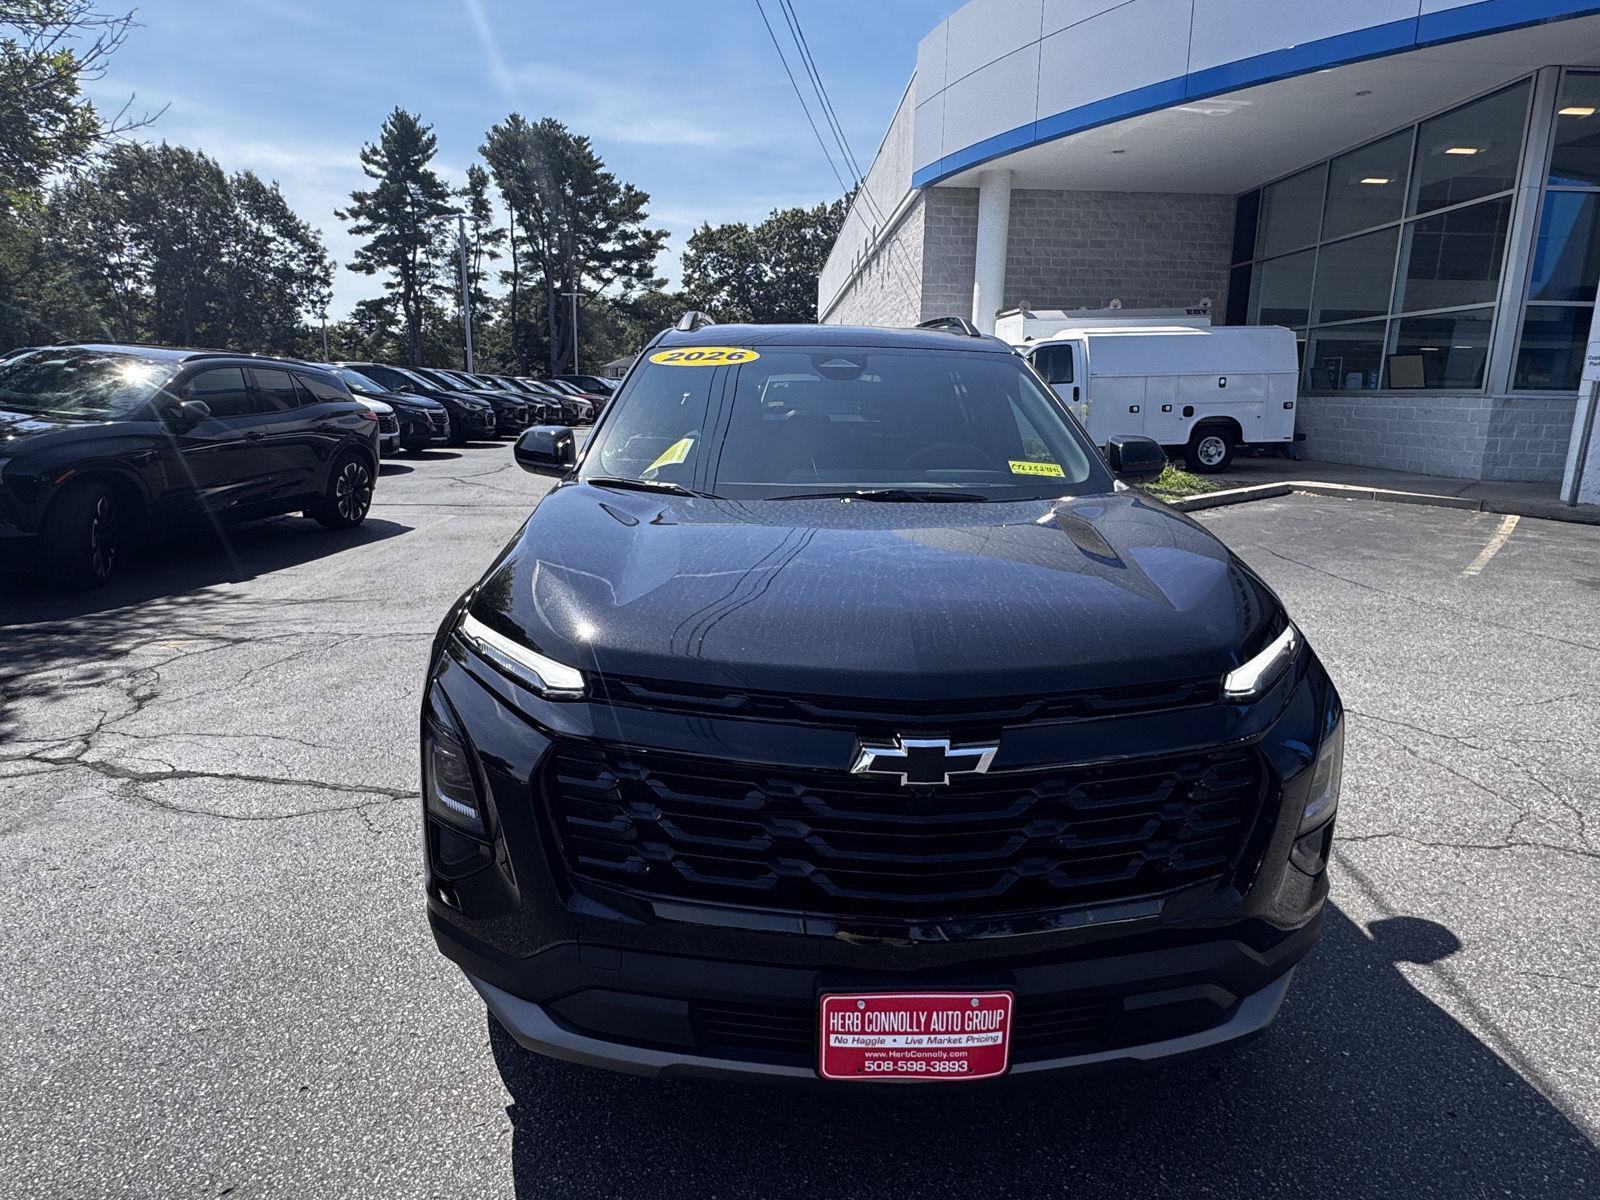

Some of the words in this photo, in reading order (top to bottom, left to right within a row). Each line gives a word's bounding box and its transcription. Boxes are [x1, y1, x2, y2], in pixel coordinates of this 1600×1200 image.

[661, 351, 748, 362] 2026
[829, 1011, 862, 1032] HERB
[865, 1011, 927, 1032] CONNOLLY
[930, 1010, 962, 1032] AUTO
[964, 1009, 1005, 1031] GROUP
[833, 1036, 849, 1045] No
[851, 1036, 886, 1046] Haggle
[905, 1036, 924, 1045] Live
[926, 1036, 963, 1045] Market
[965, 1034, 999, 1044] Pricing
[864, 1050, 968, 1059] www.HerbConnolly.com
[864, 1060, 968, 1072] 508-598-3893
